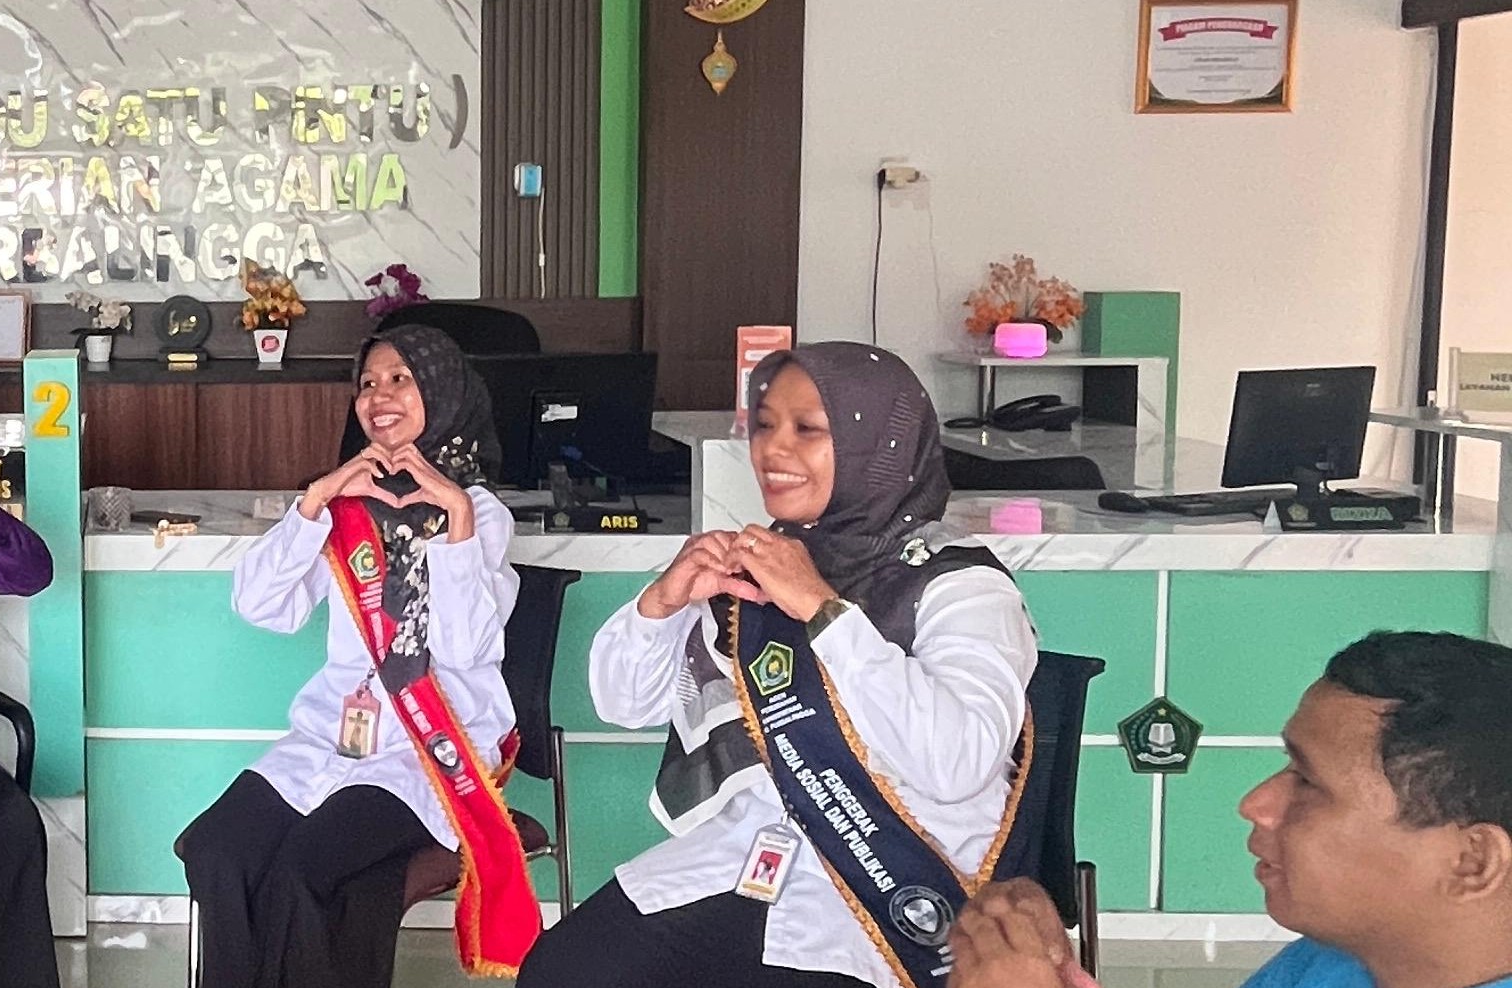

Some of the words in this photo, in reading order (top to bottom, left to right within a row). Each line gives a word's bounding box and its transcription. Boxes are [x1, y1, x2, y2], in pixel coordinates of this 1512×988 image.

[72, 81, 227, 147] SATU
[191, 152, 408, 213] AGAMA
[34, 382, 71, 437] 2
[600, 515, 638, 528] ARIS
[774, 733, 805, 773] MEDIA
[796, 767, 834, 811] SOSIAL
[824, 806, 853, 834] DAN
[843, 829, 897, 893] PUBLIKASI
[819, 767, 880, 837] PENGGERAK
